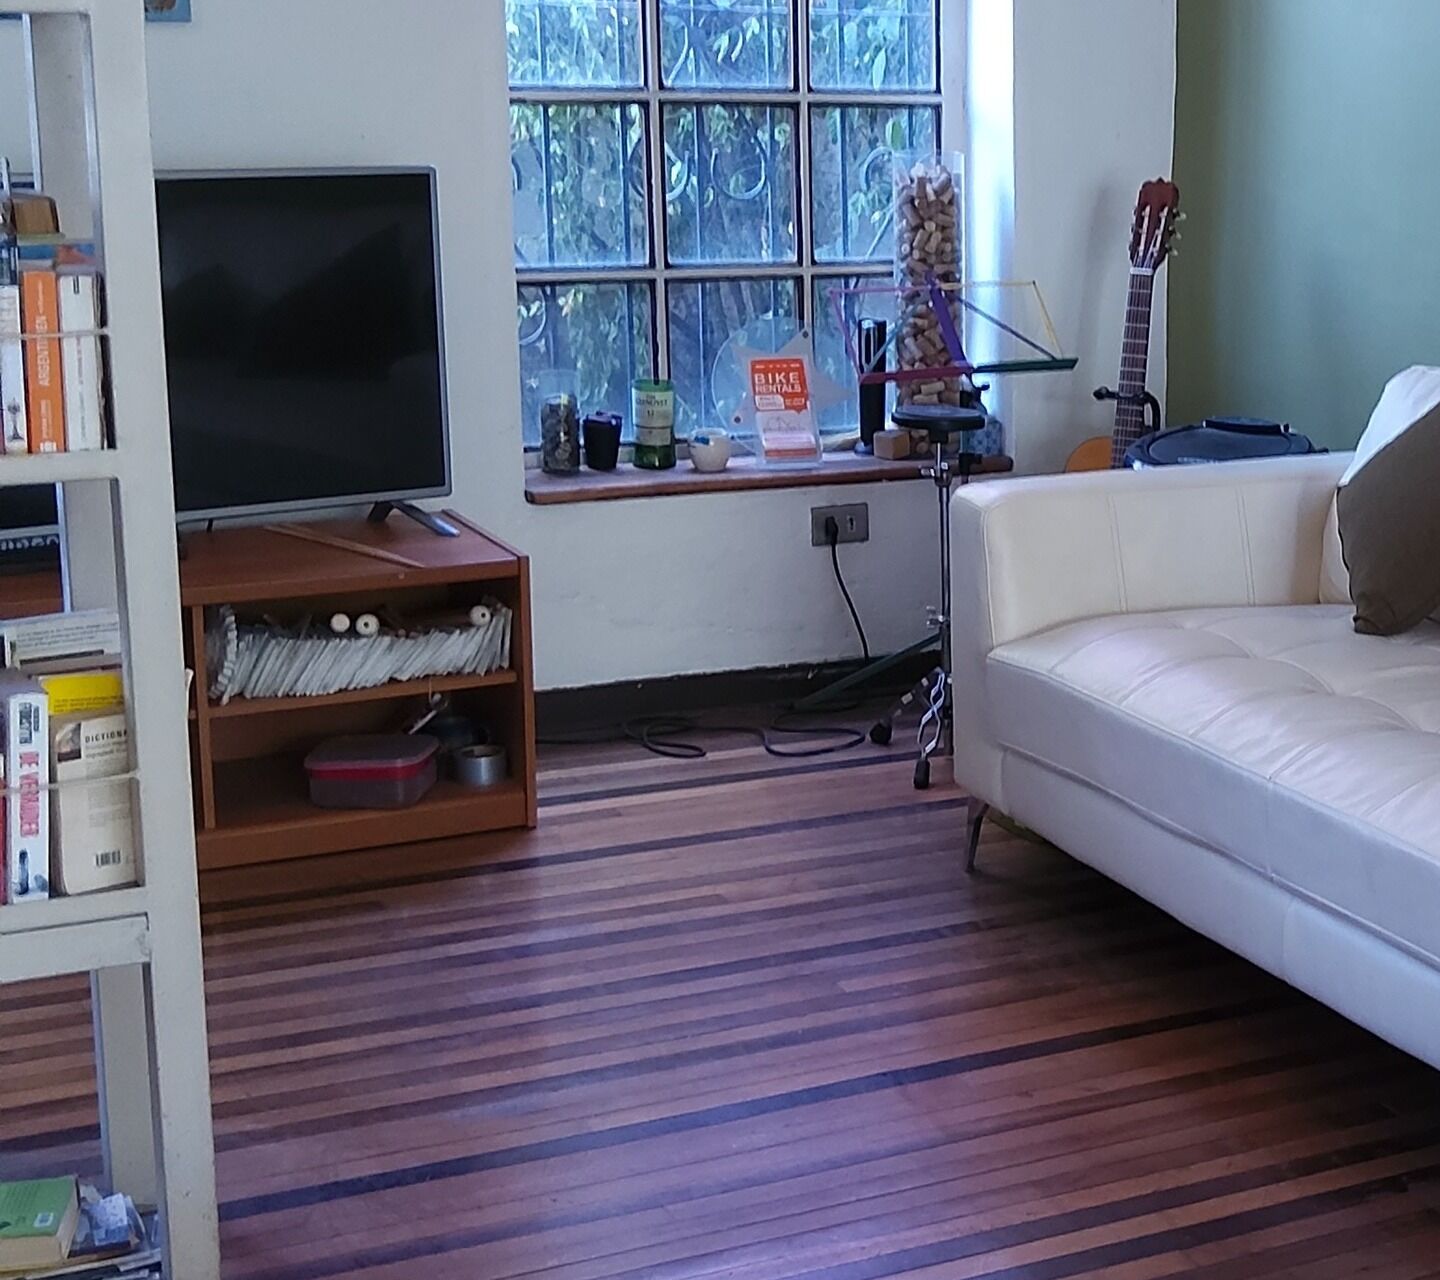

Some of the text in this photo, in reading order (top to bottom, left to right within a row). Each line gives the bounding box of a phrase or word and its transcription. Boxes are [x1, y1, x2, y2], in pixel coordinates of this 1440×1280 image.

[36, 316, 50, 386] ARGENTIIEN
[754, 372, 800, 384] BIKE
[755, 383, 802, 393] RENTALS
